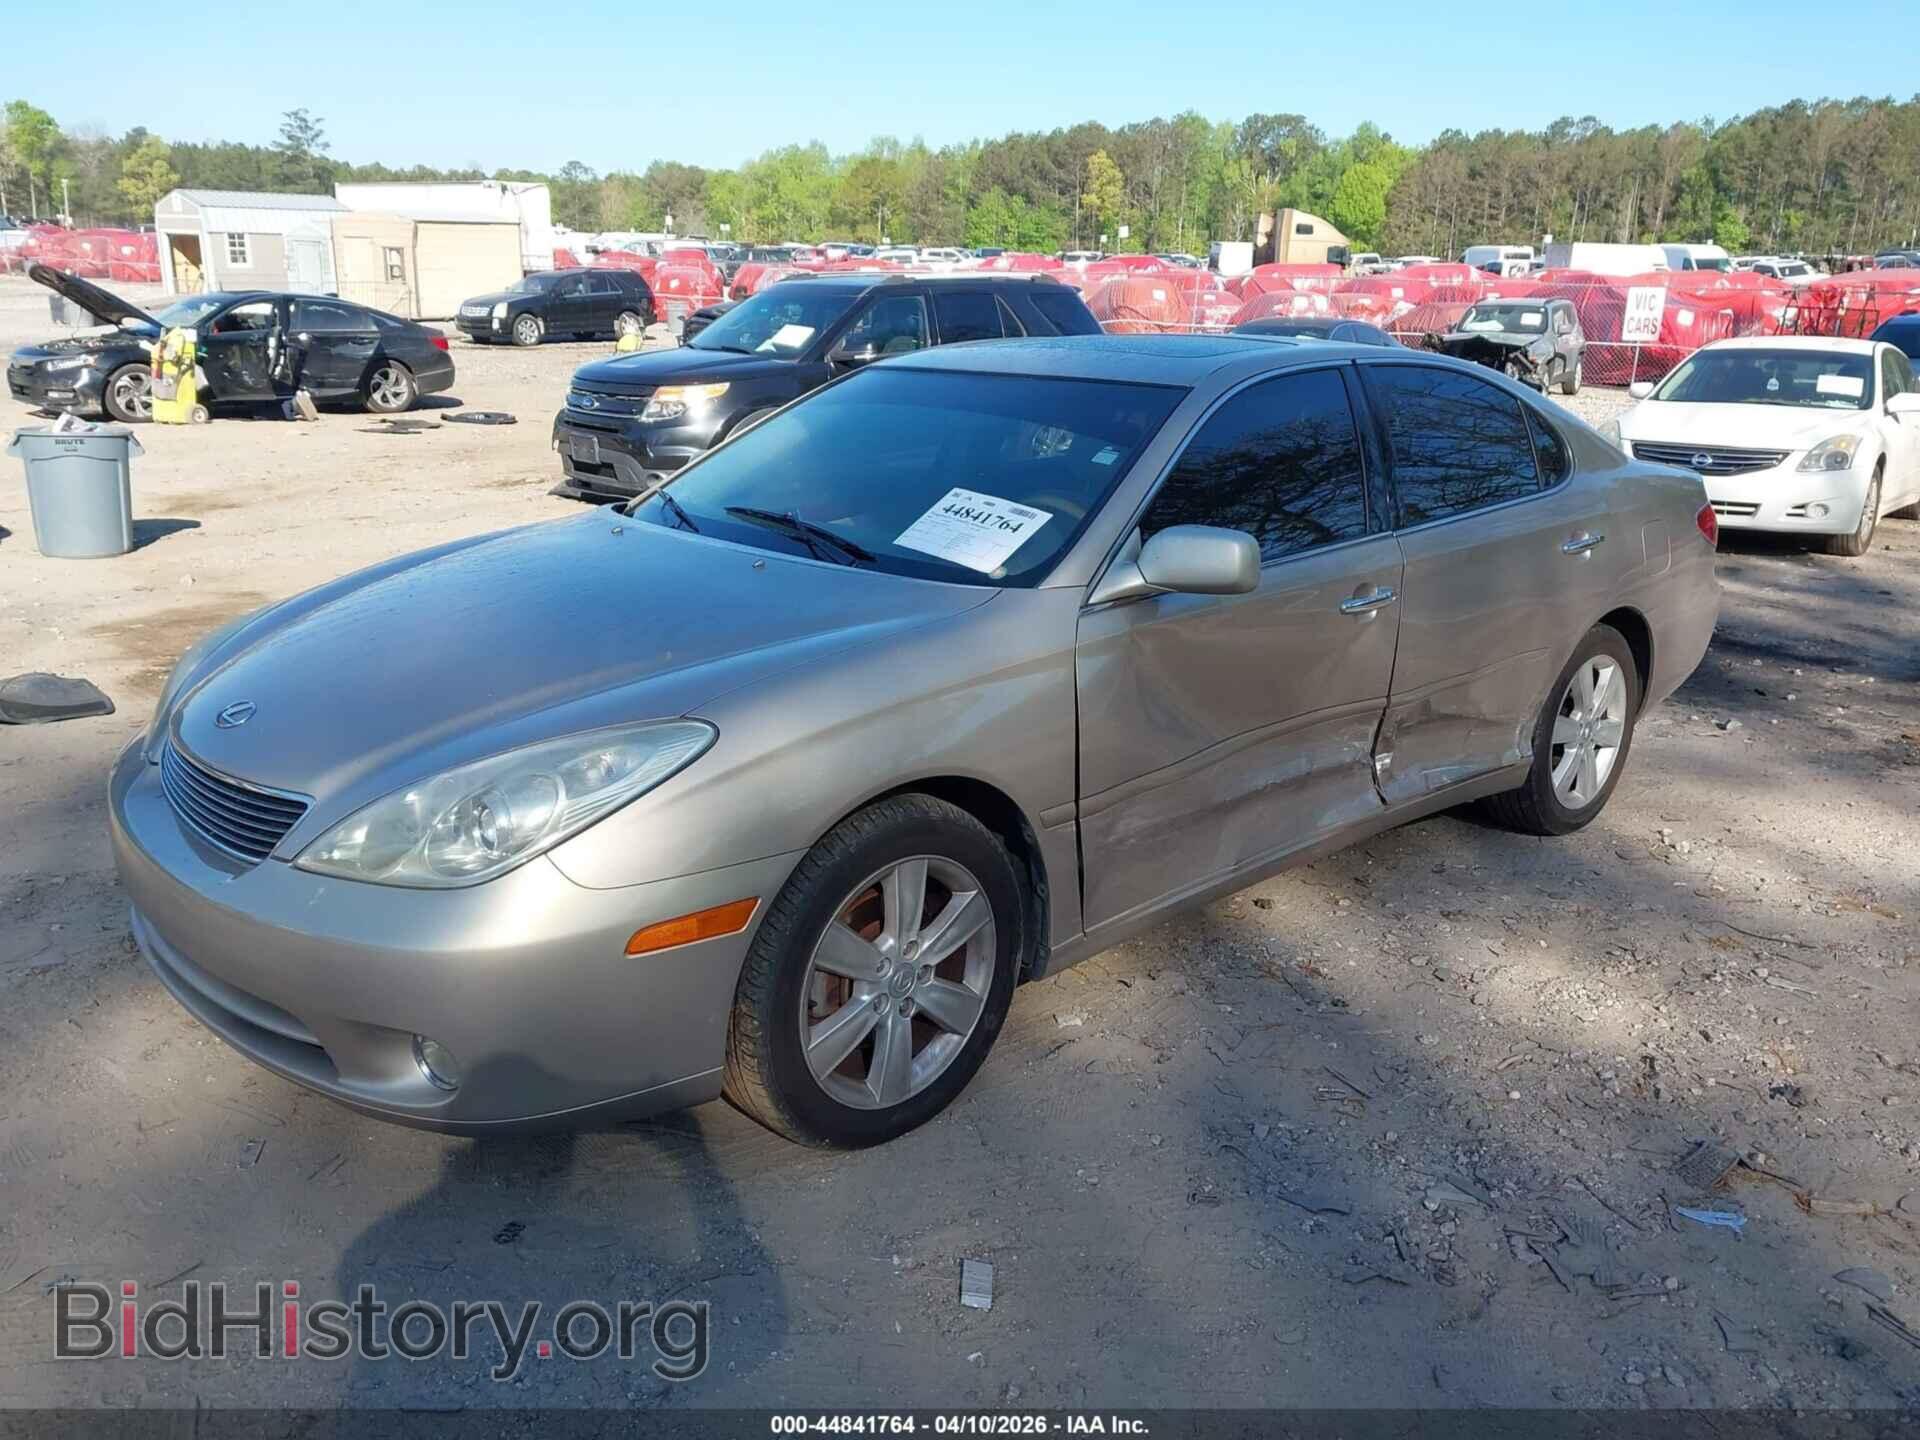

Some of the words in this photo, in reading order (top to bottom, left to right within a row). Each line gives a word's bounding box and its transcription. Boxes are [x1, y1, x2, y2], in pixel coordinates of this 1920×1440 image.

[1635, 291, 1656, 311] VIC
[1626, 316, 1658, 335] CARS
[942, 503, 1025, 534] 44841764
